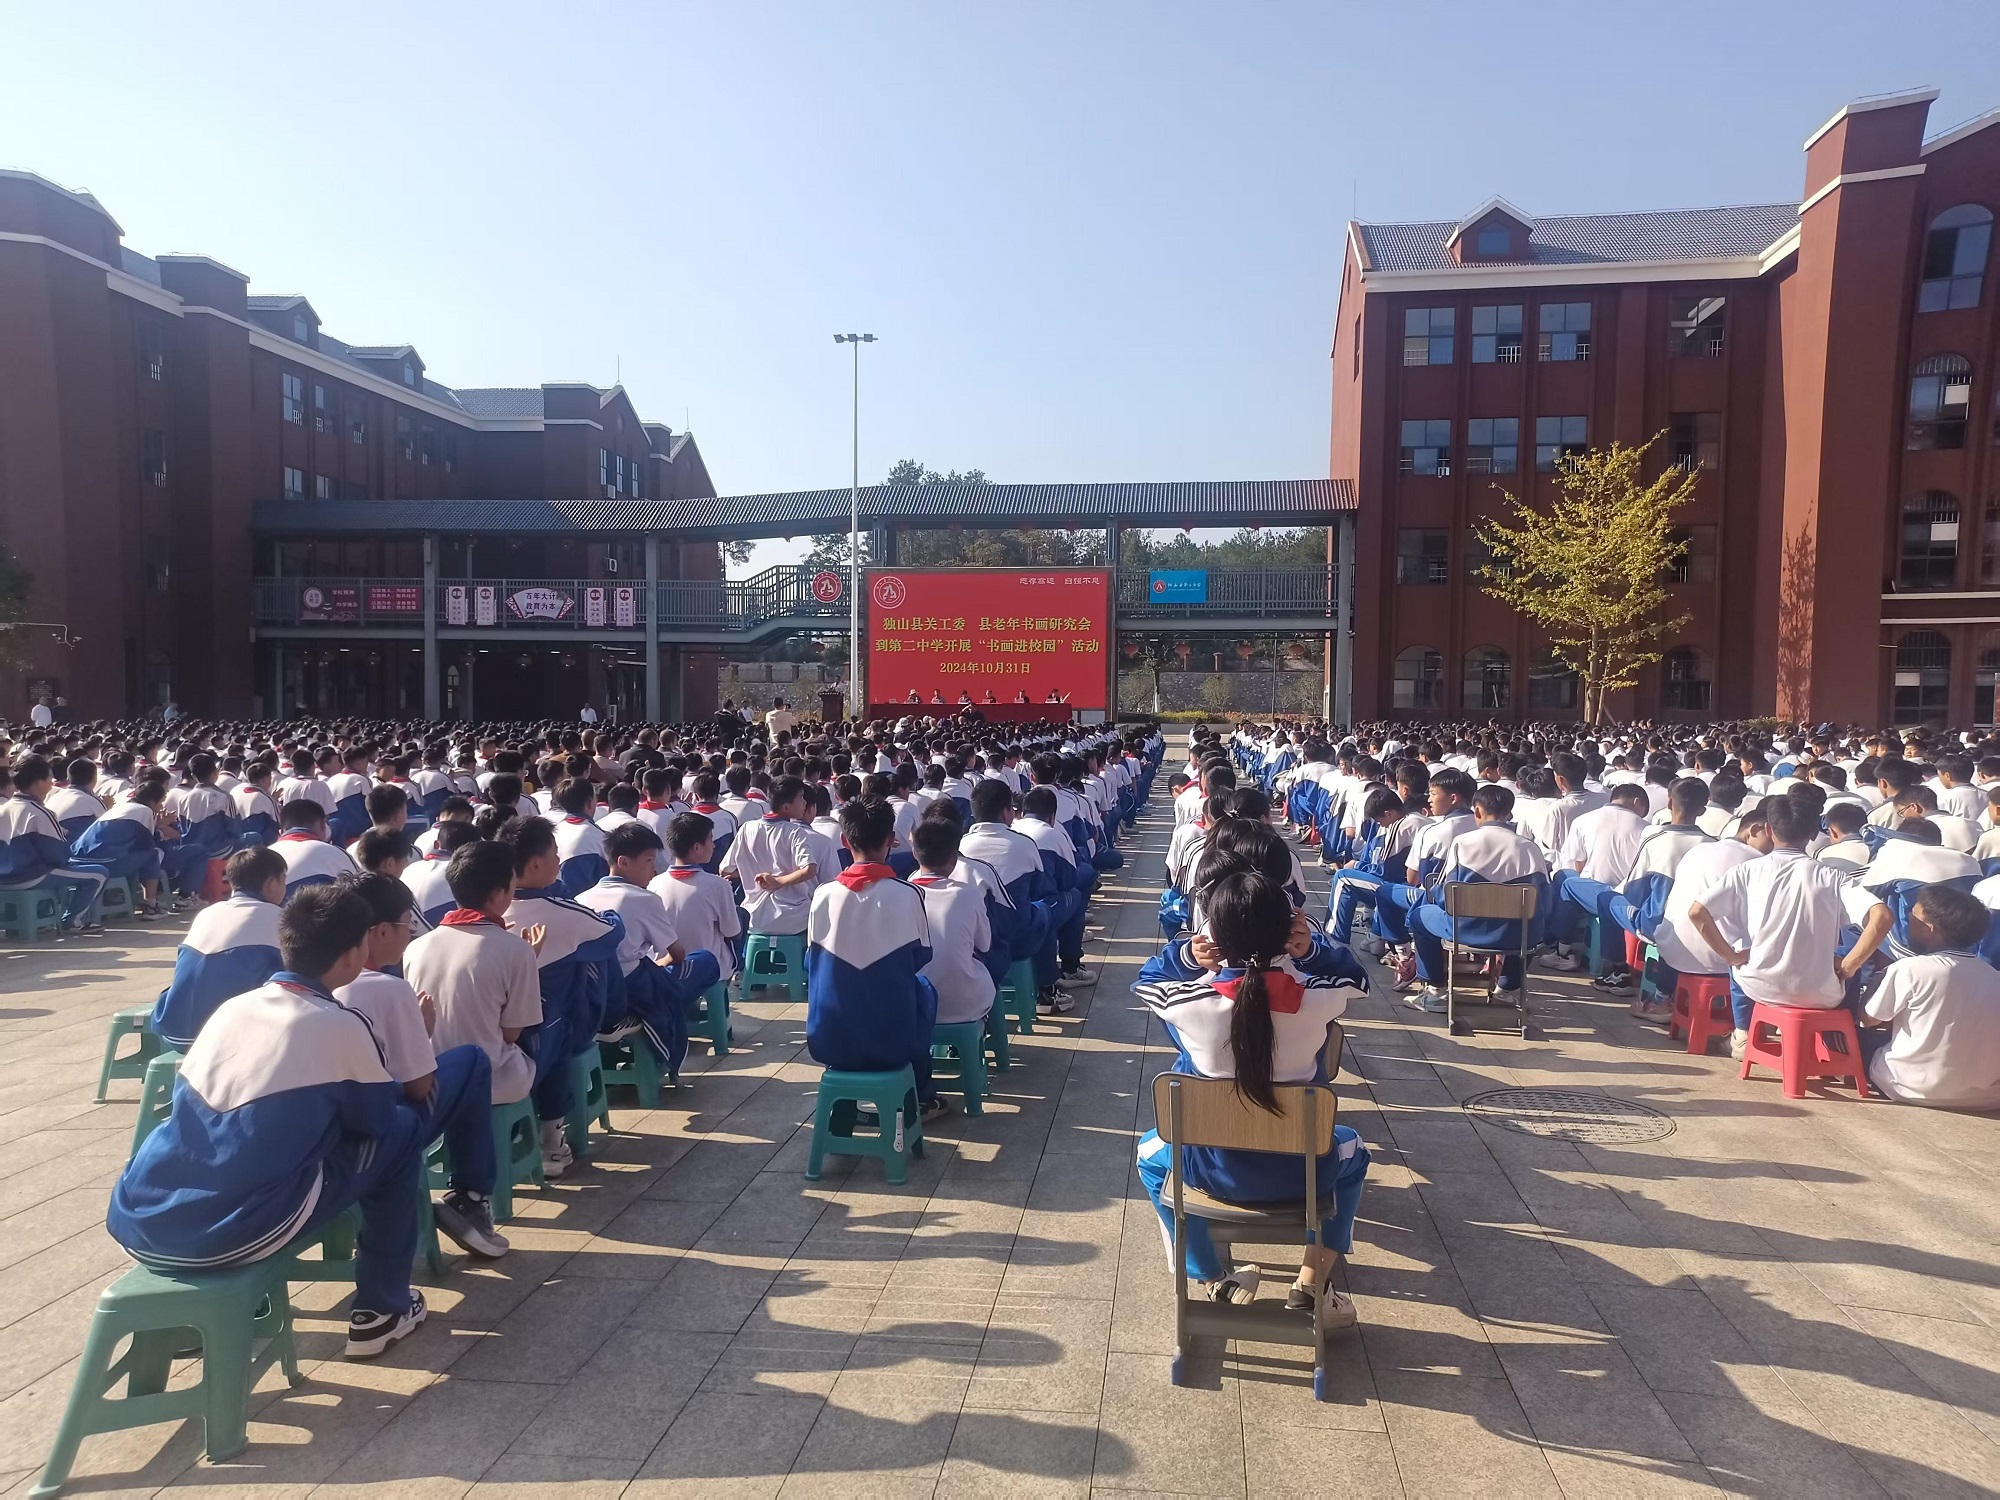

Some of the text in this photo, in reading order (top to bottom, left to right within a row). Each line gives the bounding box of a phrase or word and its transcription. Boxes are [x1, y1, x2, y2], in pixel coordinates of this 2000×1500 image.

[1064, 577, 1100, 585] 自强不息
[526, 592, 556, 601] 百年大计
[526, 602, 556, 611] 教育为本
[882, 617, 1092, 631] 独山县关工委 县老年书画研究会
[940, 662, 1031, 675] 2024年10月31日
